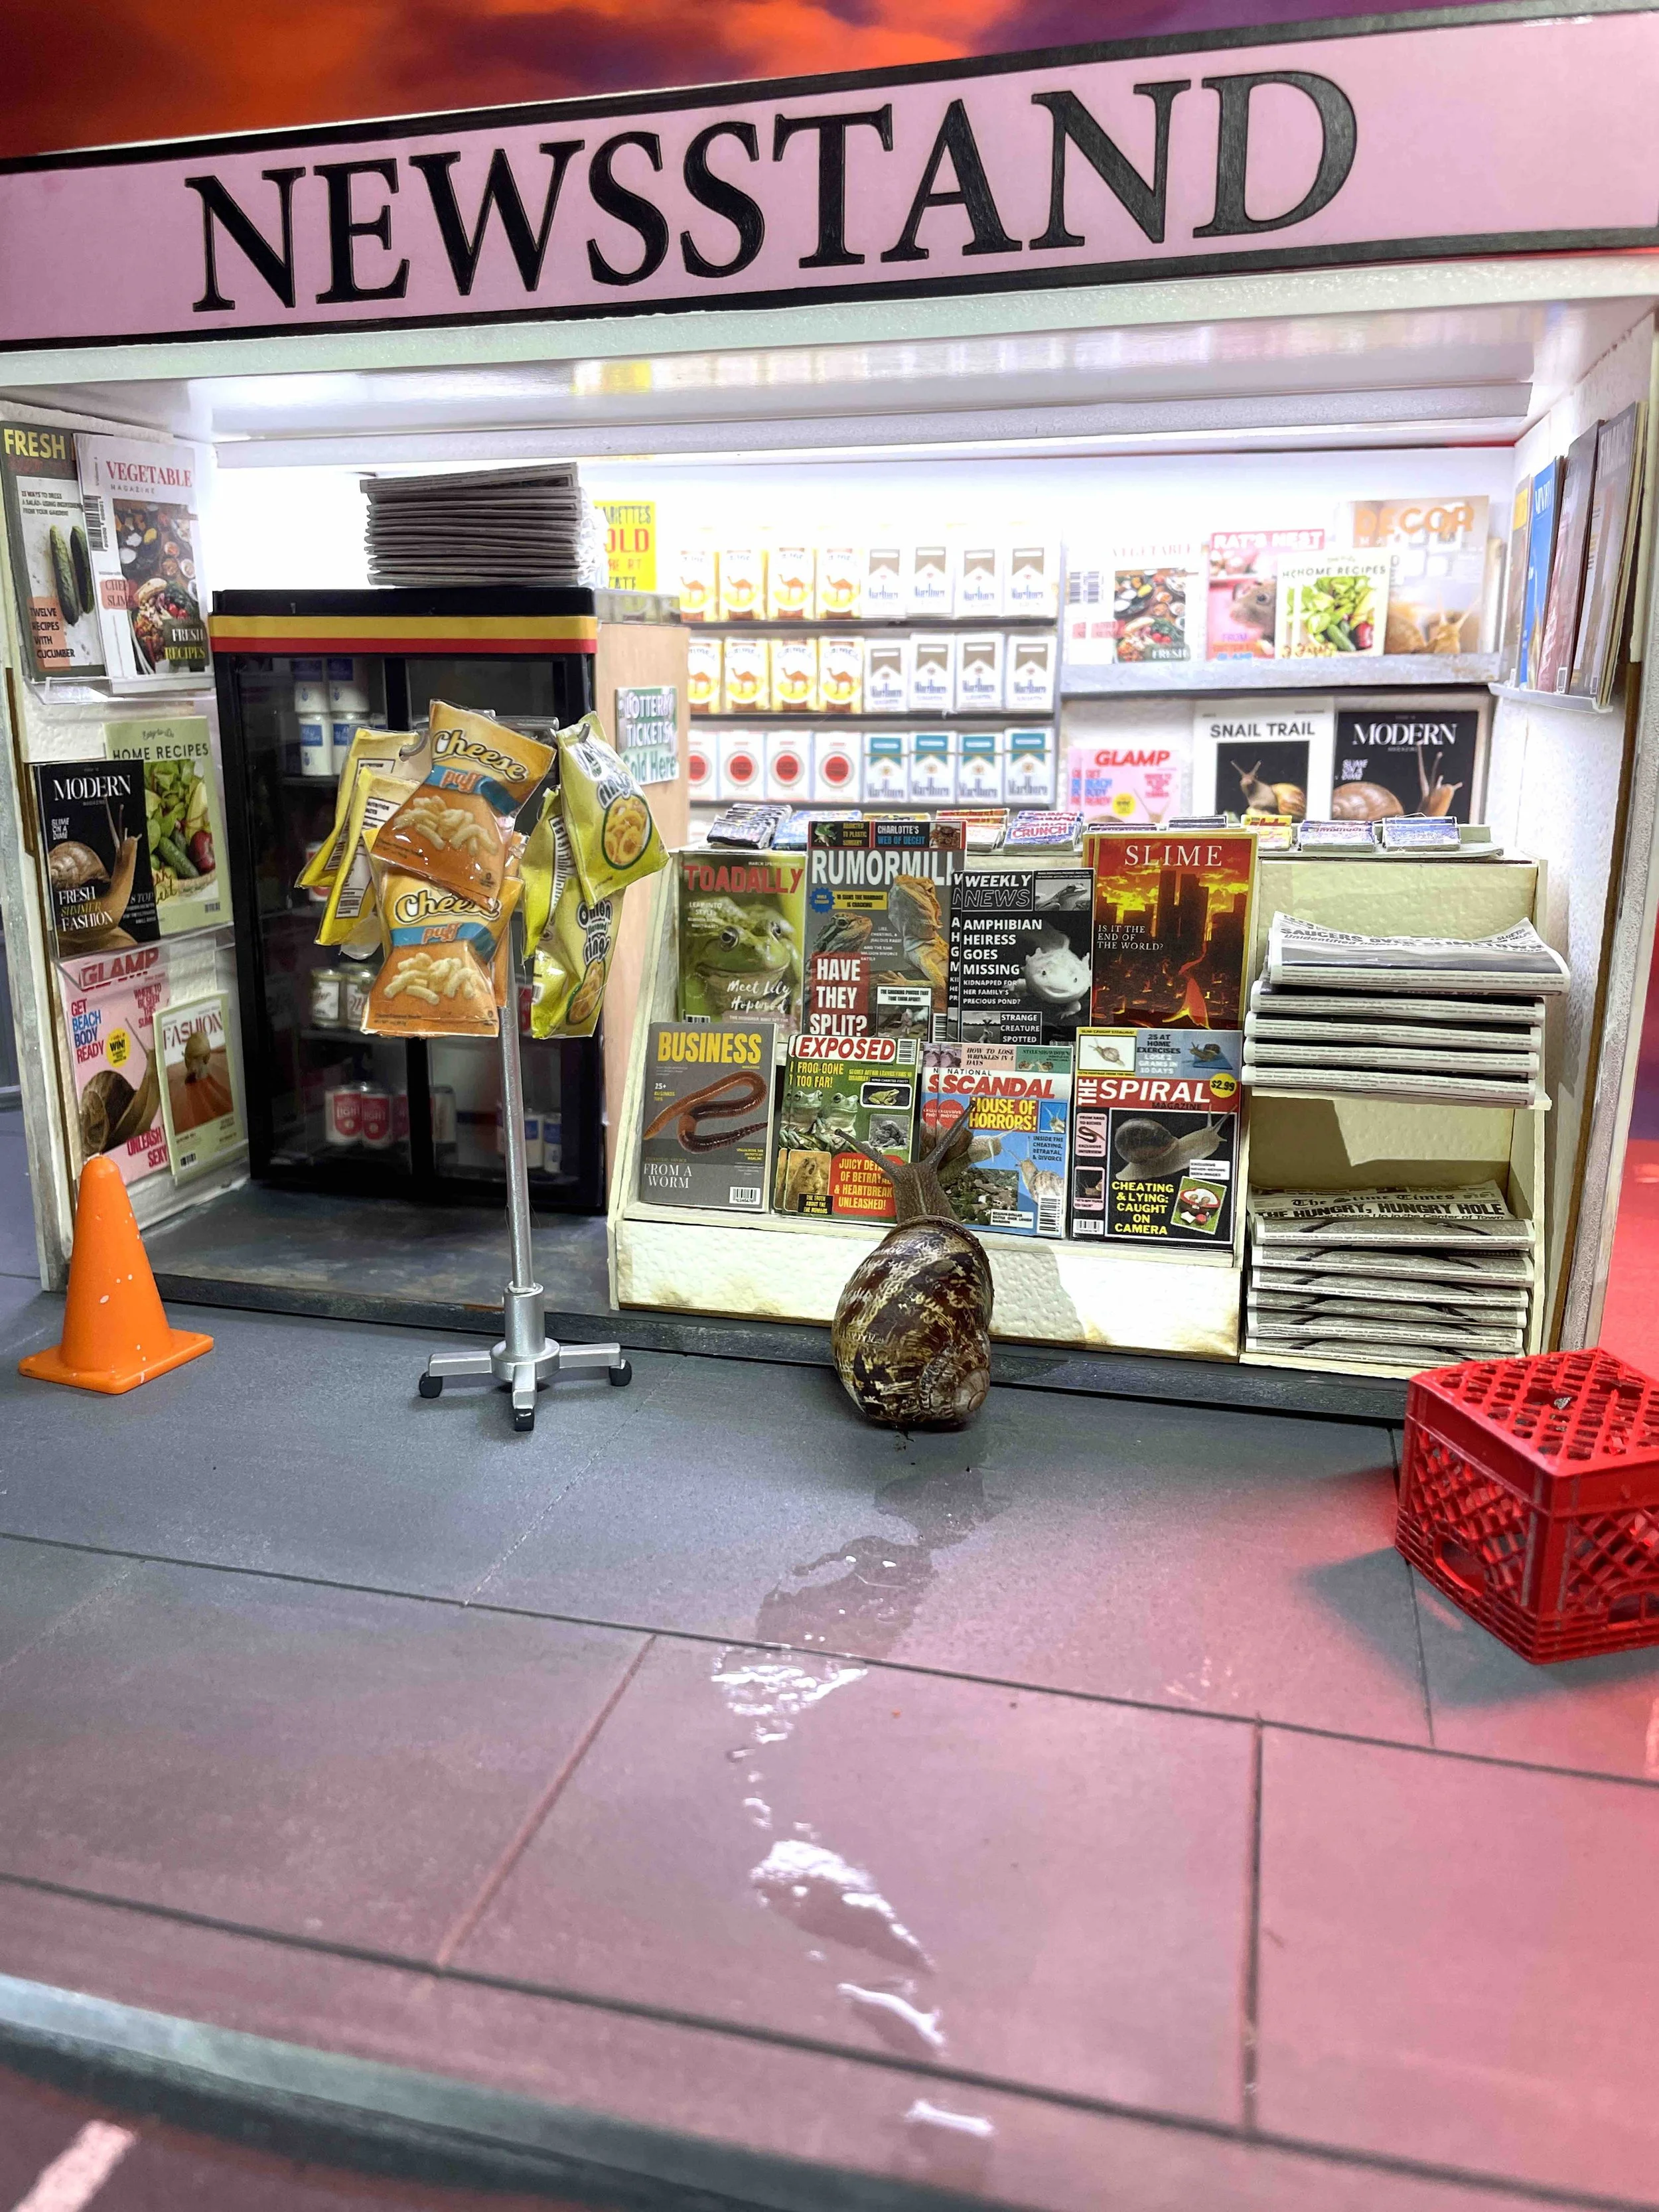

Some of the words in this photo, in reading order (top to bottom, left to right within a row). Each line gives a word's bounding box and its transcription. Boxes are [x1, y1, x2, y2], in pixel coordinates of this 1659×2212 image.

[186, 72, 1357, 312] NEWSSTAND
[4, 428, 66, 460] FRESH
[106, 461, 192, 488] VEGETABLE
[110, 484, 155, 494] MAGAZINE
[1354, 506, 1475, 536] DECOR
[1214, 533, 1268, 550] RAT'S
[1271, 531, 1323, 548] NEST
[1337, 564, 1387, 575] RECIPES
[105, 579, 128, 591] CHEF
[31, 608, 58, 617] TWELVE
[33, 622, 60, 631] RECIPES
[172, 628, 205, 642] FRESH
[35, 636, 53, 645] WITH
[37, 648, 76, 659] CUCUMBER
[165, 647, 206, 660] RECIPES
[624, 694, 673, 719] LOTTERY
[626, 720, 674, 747] TICKETS
[1210, 723, 1261, 739] SNAIL
[1267, 721, 1316, 737] TRAIL
[1352, 722, 1458, 746] MODERN
[113, 747, 150, 760] HOME
[157, 743, 209, 759] RECIPES
[431, 729, 530, 783] Cheese
[1095, 749, 1171, 767] GLAMP
[650, 750, 676, 781] Here
[54, 774, 131, 802] MODERN
[439, 768, 480, 794] puff
[877, 825, 920, 835] CHARLOTTE'S
[1012, 826, 1068, 839] CRUNCH
[903, 836, 926, 845] DECEIT
[1124, 844, 1223, 867] SLIME
[811, 849, 958, 887] RUMORMILL
[684, 865, 804, 894] TOADALLY
[965, 874, 1033, 888] WEEKLY
[58, 886, 96, 906] FRESH
[964, 889, 1031, 909] NEWS
[62, 911, 113, 932] FASHION
[963, 919, 1043, 931] AMPHIBIAN
[1097, 924, 1109, 933] IS
[1125, 925, 1146, 934] THE
[422, 922, 461, 944] puff
[963, 934, 1017, 946] HEIRESS
[1097, 933, 1119, 942] END
[1280, 929, 1364, 942] SAUCERS
[1283, 934, 1358, 946] Unidentified
[963, 948, 998, 961] GOES
[1096, 941, 1118, 950] THE
[1121, 942, 1164, 951] WORLD?
[81, 947, 159, 988] GLAMP
[816, 958, 861, 982] HAVE
[963, 964, 1021, 976] MISSING
[727, 979, 759, 994] Meet
[762, 980, 792, 999] Lily
[731, 995, 788, 1015] Hopwood
[816, 986, 858, 1010] THEY
[71, 998, 87, 1017] GET
[72, 1009, 102, 1031] BEACH
[810, 1013, 868, 1037] SPLIT?
[74, 1027, 99, 1049] BODY
[163, 1010, 223, 1051] FASHION
[76, 1041, 104, 1064] READY
[109, 1040, 125, 1051] WIN!
[657, 1031, 762, 1064] BUSINESS
[798, 1036, 895, 1061] EXPOSED
[797, 1062, 844, 1075] FROG-GONE
[796, 1075, 813, 1087] TOO
[814, 1076, 833, 1088] FAR!
[941, 1074, 1056, 1099] SCANDAL
[1211, 1079, 1236, 1092] $2.99
[1078, 1078, 1098, 1105] THE
[1099, 1079, 1211, 1103] SPIRAL
[972, 1097, 1013, 1116] HOUSE
[1019, 1100, 1037, 1114] OF
[1151, 1102, 1202, 1110] MAGAZINE
[970, 1112, 1037, 1131] HORRORS!
[126, 1128, 163, 1157] UNLEASH
[644, 1163, 680, 1177] FROM
[684, 1165, 692, 1177] A
[839, 1157, 861, 1170] JUICY
[648, 1175, 689, 1189] WORM
[840, 1171, 851, 1182] OF
[834, 1184, 841, 1194] &
[843, 1185, 893, 1199] HEARTBREAK
[1111, 1181, 1174, 1193] CHEATING
[838, 1197, 887, 1211] UNLEASHED!
[1116, 1192, 1126, 1201] &
[1128, 1193, 1169, 1203] LYING:
[1116, 1203, 1168, 1214] CAUGHT
[1255, 1210, 1289, 1218] THE
[1293, 1204, 1372, 1218] HUNGRY,
[1377, 1203, 1453, 1215] HUNGRY
[1456, 1203, 1505, 1215] HOLE
[1132, 1213, 1151, 1223] ON
[1114, 1223, 1168, 1235] CAMERA
